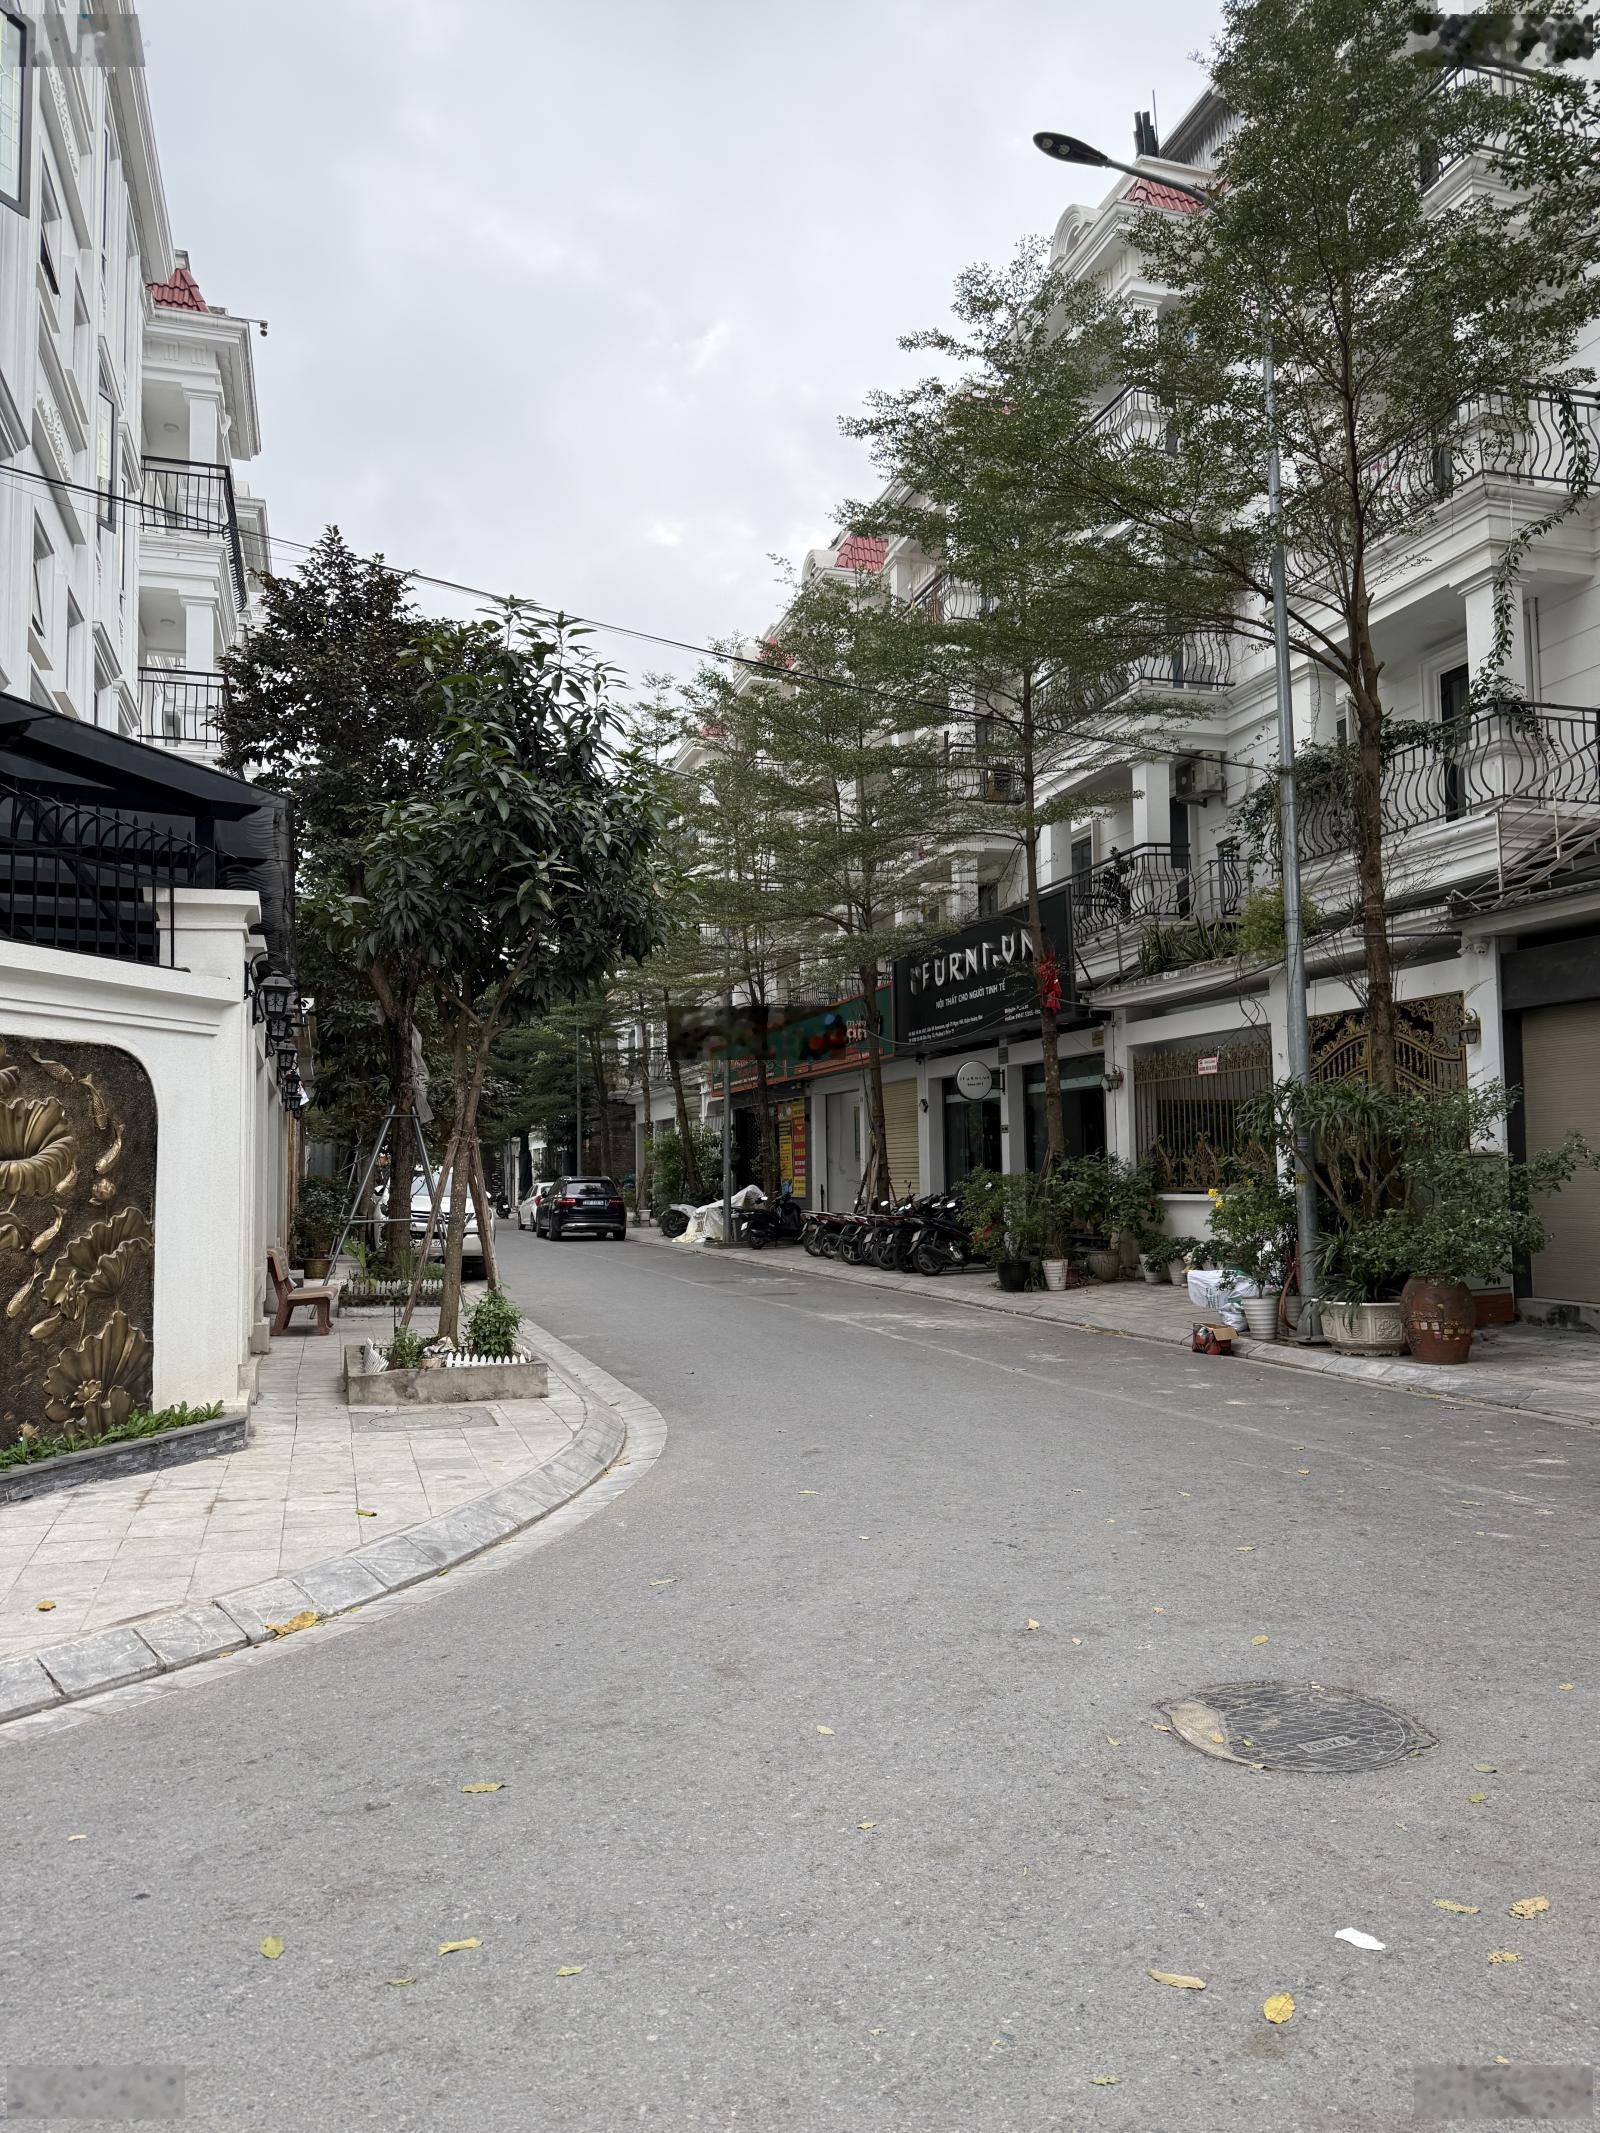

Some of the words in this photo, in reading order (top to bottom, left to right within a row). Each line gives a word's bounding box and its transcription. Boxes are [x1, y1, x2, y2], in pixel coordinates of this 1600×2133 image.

[945, 993, 957, 1006] THẤT
[958, 992, 968, 1003] CHO
[969, 985, 985, 1000] NGƯỜI
[985, 984, 998, 996] TINH
[999, 977, 1006, 991] TẾ
